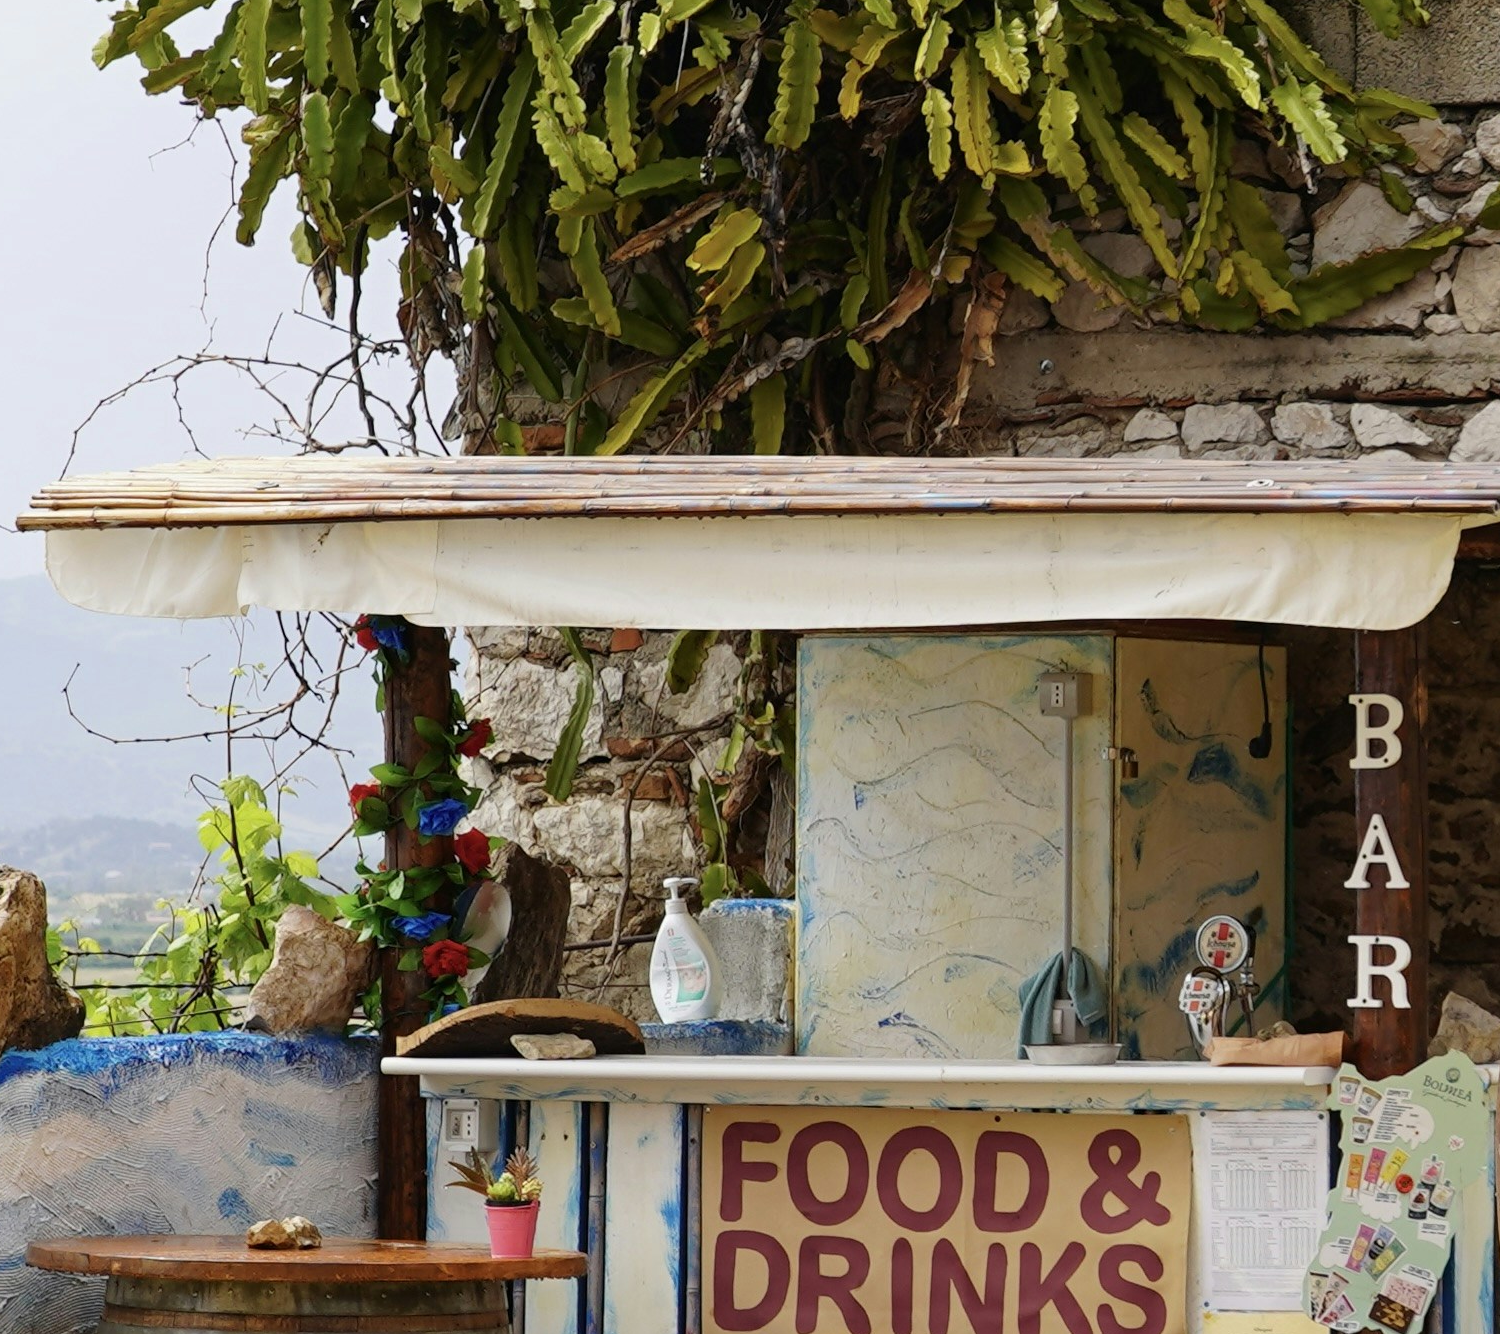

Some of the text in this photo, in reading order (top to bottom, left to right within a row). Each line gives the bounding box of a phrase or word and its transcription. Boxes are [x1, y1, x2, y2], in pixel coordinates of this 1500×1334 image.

[1344, 691, 1412, 1011] BAR
[720, 1120, 1050, 1233] FOOD
[1079, 1128, 1171, 1235] &
